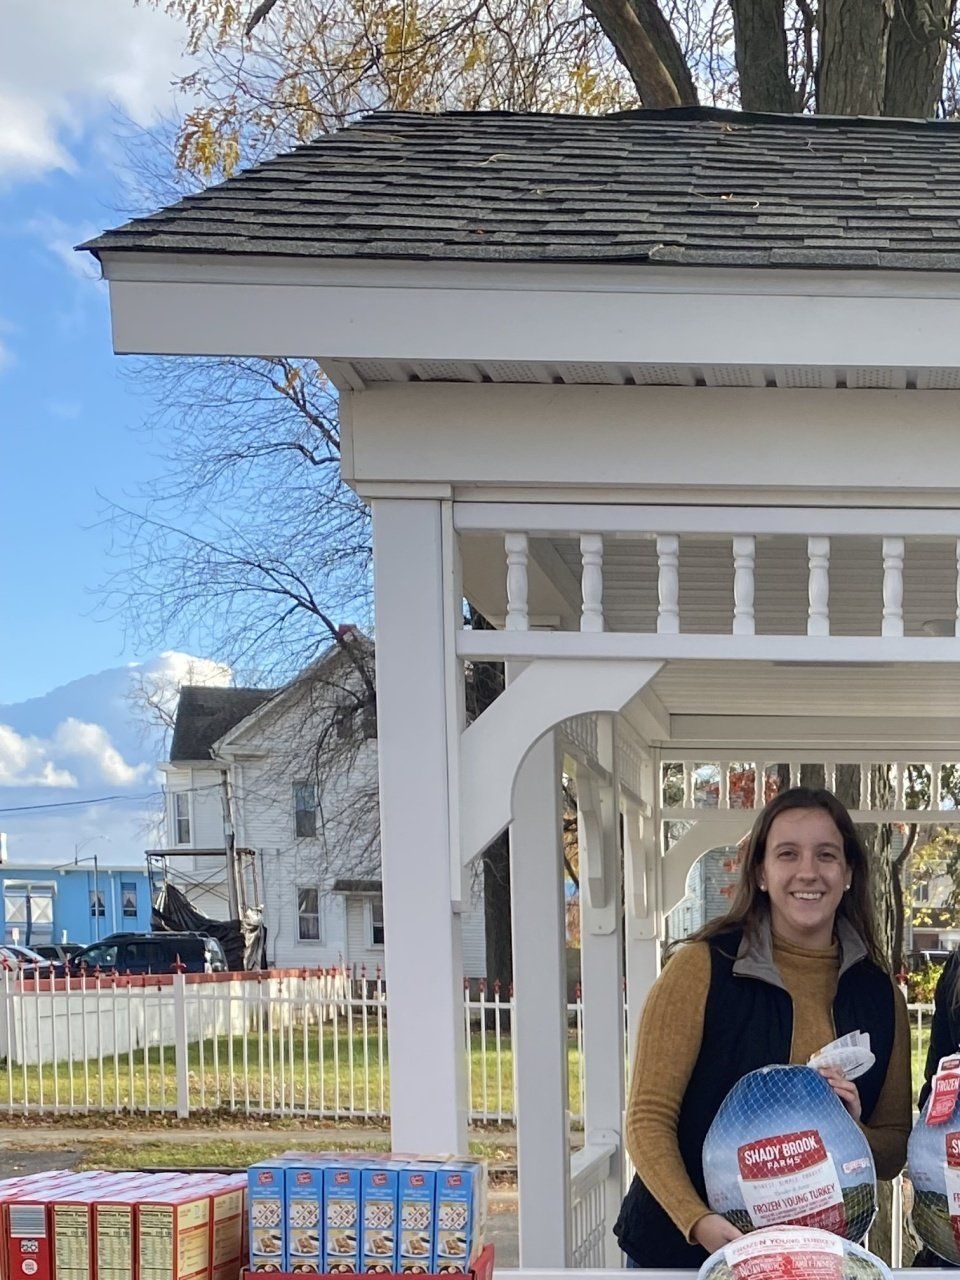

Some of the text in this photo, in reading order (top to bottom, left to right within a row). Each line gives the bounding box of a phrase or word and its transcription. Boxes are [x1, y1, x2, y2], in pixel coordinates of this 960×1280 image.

[936, 1079, 959, 1093] FROZEN
[744, 1136, 818, 1165] SHADY BROOK
[767, 1156, 801, 1170] FARMS
[753, 1201, 782, 1216] FROZEN
[783, 1193, 808, 1210] YOUNG
[809, 1183, 835, 1200] TURKEY
